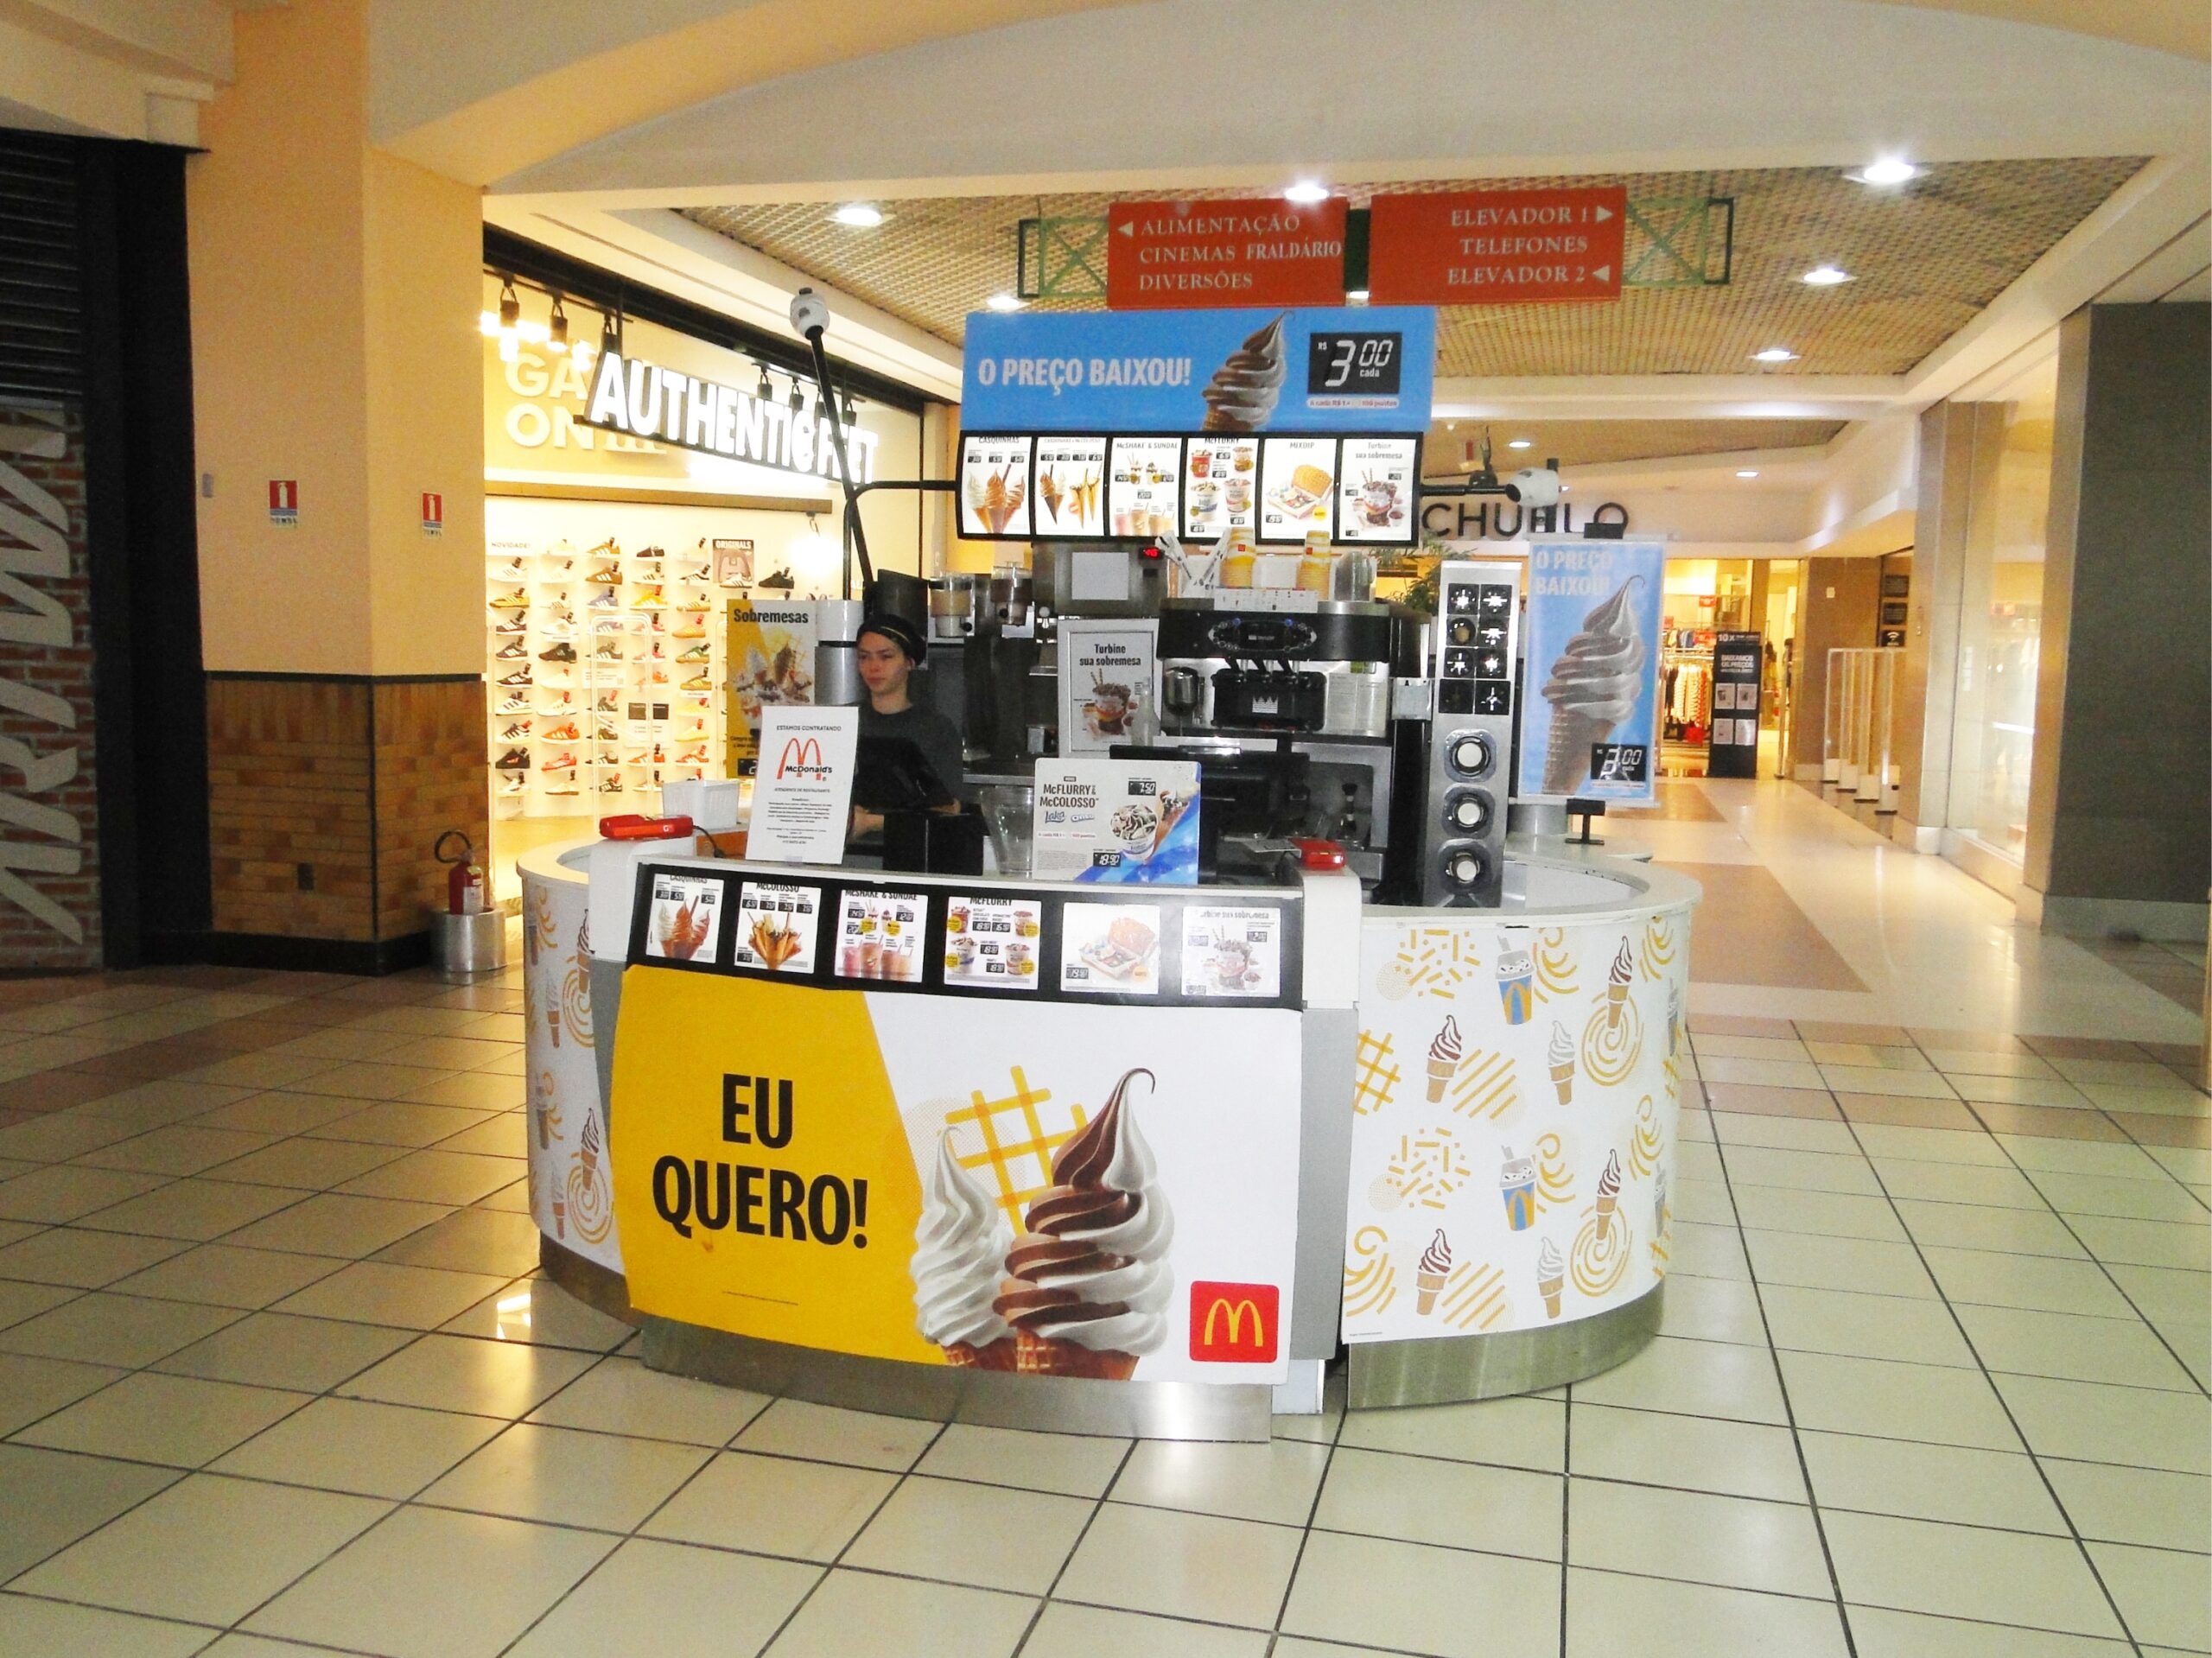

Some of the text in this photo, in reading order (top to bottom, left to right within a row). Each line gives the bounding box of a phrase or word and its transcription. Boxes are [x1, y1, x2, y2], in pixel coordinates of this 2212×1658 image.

[1141, 213, 1300, 236] ALIMENTAÇÃO
[1451, 206, 1588, 227] ELEVADOR 1
[1140, 237, 1342, 264] CINEMAS FRALDÁRIO
[1459, 235, 1588, 255] TELEFONES
[1139, 270, 1253, 291] DIVERSÕES
[1447, 265, 1586, 285] ELEVADOR 2
[978, 358, 1192, 397] O PREÇO BAIXOU!
[1359, 368, 1380, 378] cada
[584, 352, 815, 473] AUTHENTIC
[505, 403, 594, 450] ON
[715, 541, 752, 549] ORIGINALS
[734, 608, 809, 624] Sobremesas
[1094, 644, 1127, 654] Turbine
[1096, 655, 1141, 666] sobremesa
[785, 765, 833, 774] McDonald's
[1043, 784, 1091, 795] McFLURRY
[722, 1073, 793, 1149] EU
[652, 1155, 868, 1249] QUERO!
